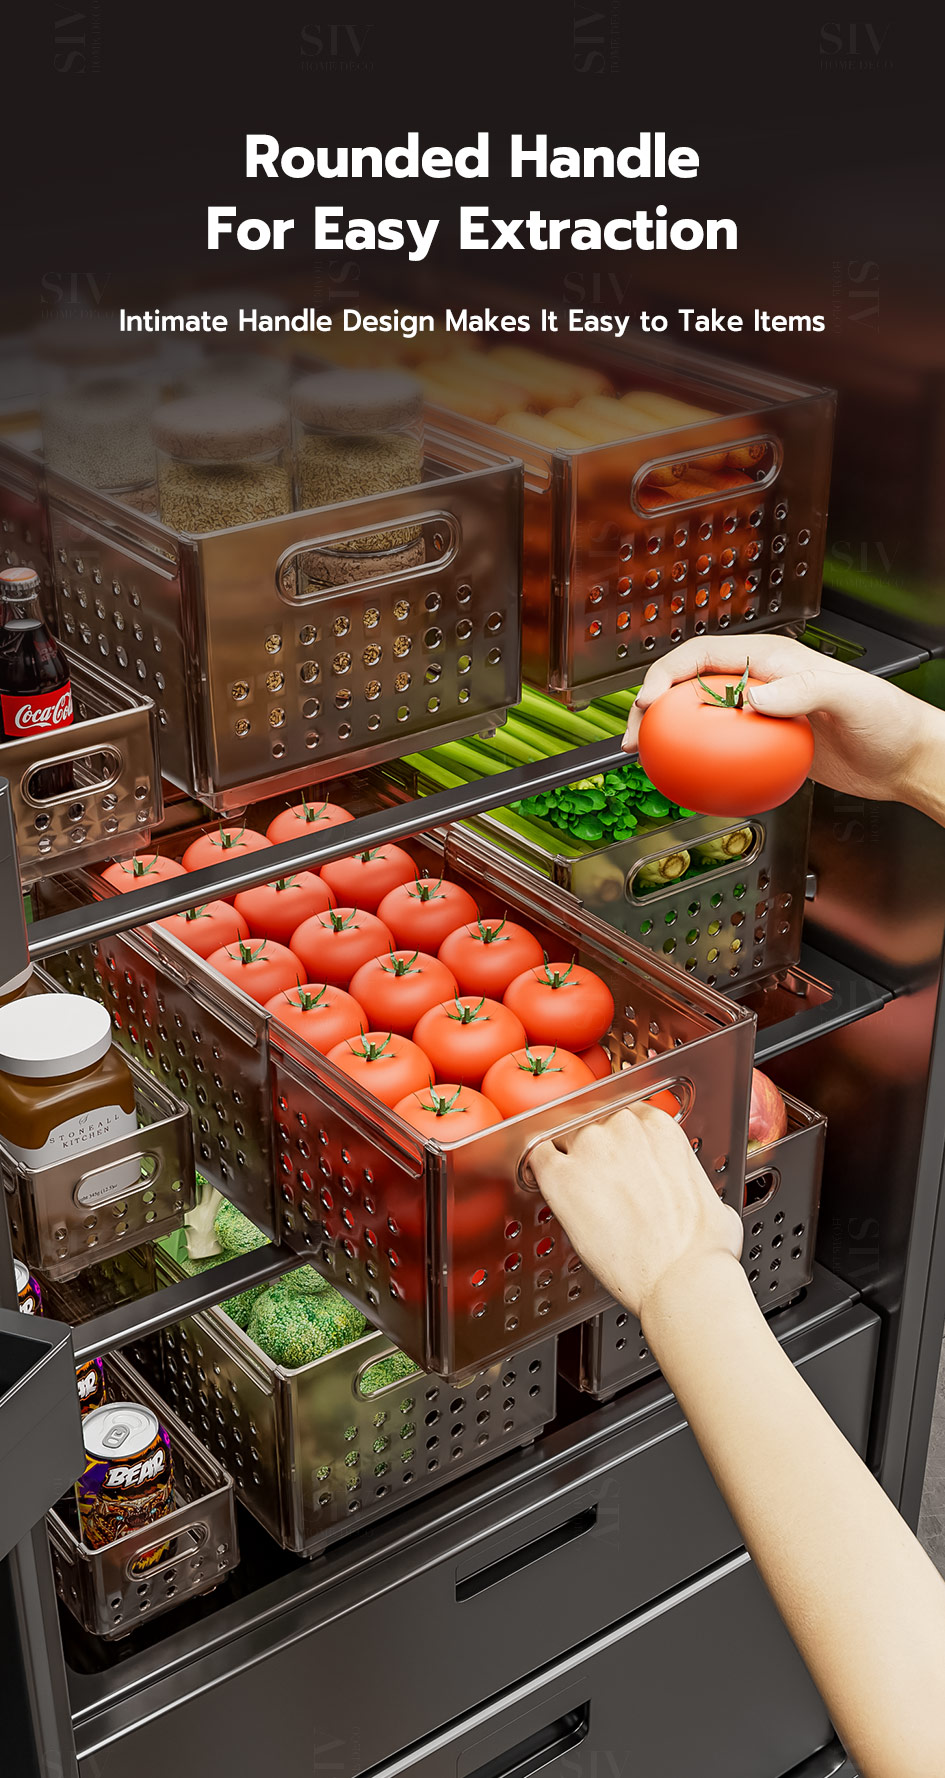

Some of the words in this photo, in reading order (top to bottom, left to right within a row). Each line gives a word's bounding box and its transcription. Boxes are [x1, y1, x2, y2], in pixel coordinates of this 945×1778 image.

[15, 688, 73, 729] Coca-Col
[49, 1114, 120, 1144] STONEALL
[62, 1126, 110, 1149] KITCHEN
[104, 1449, 165, 1488] BEAR
